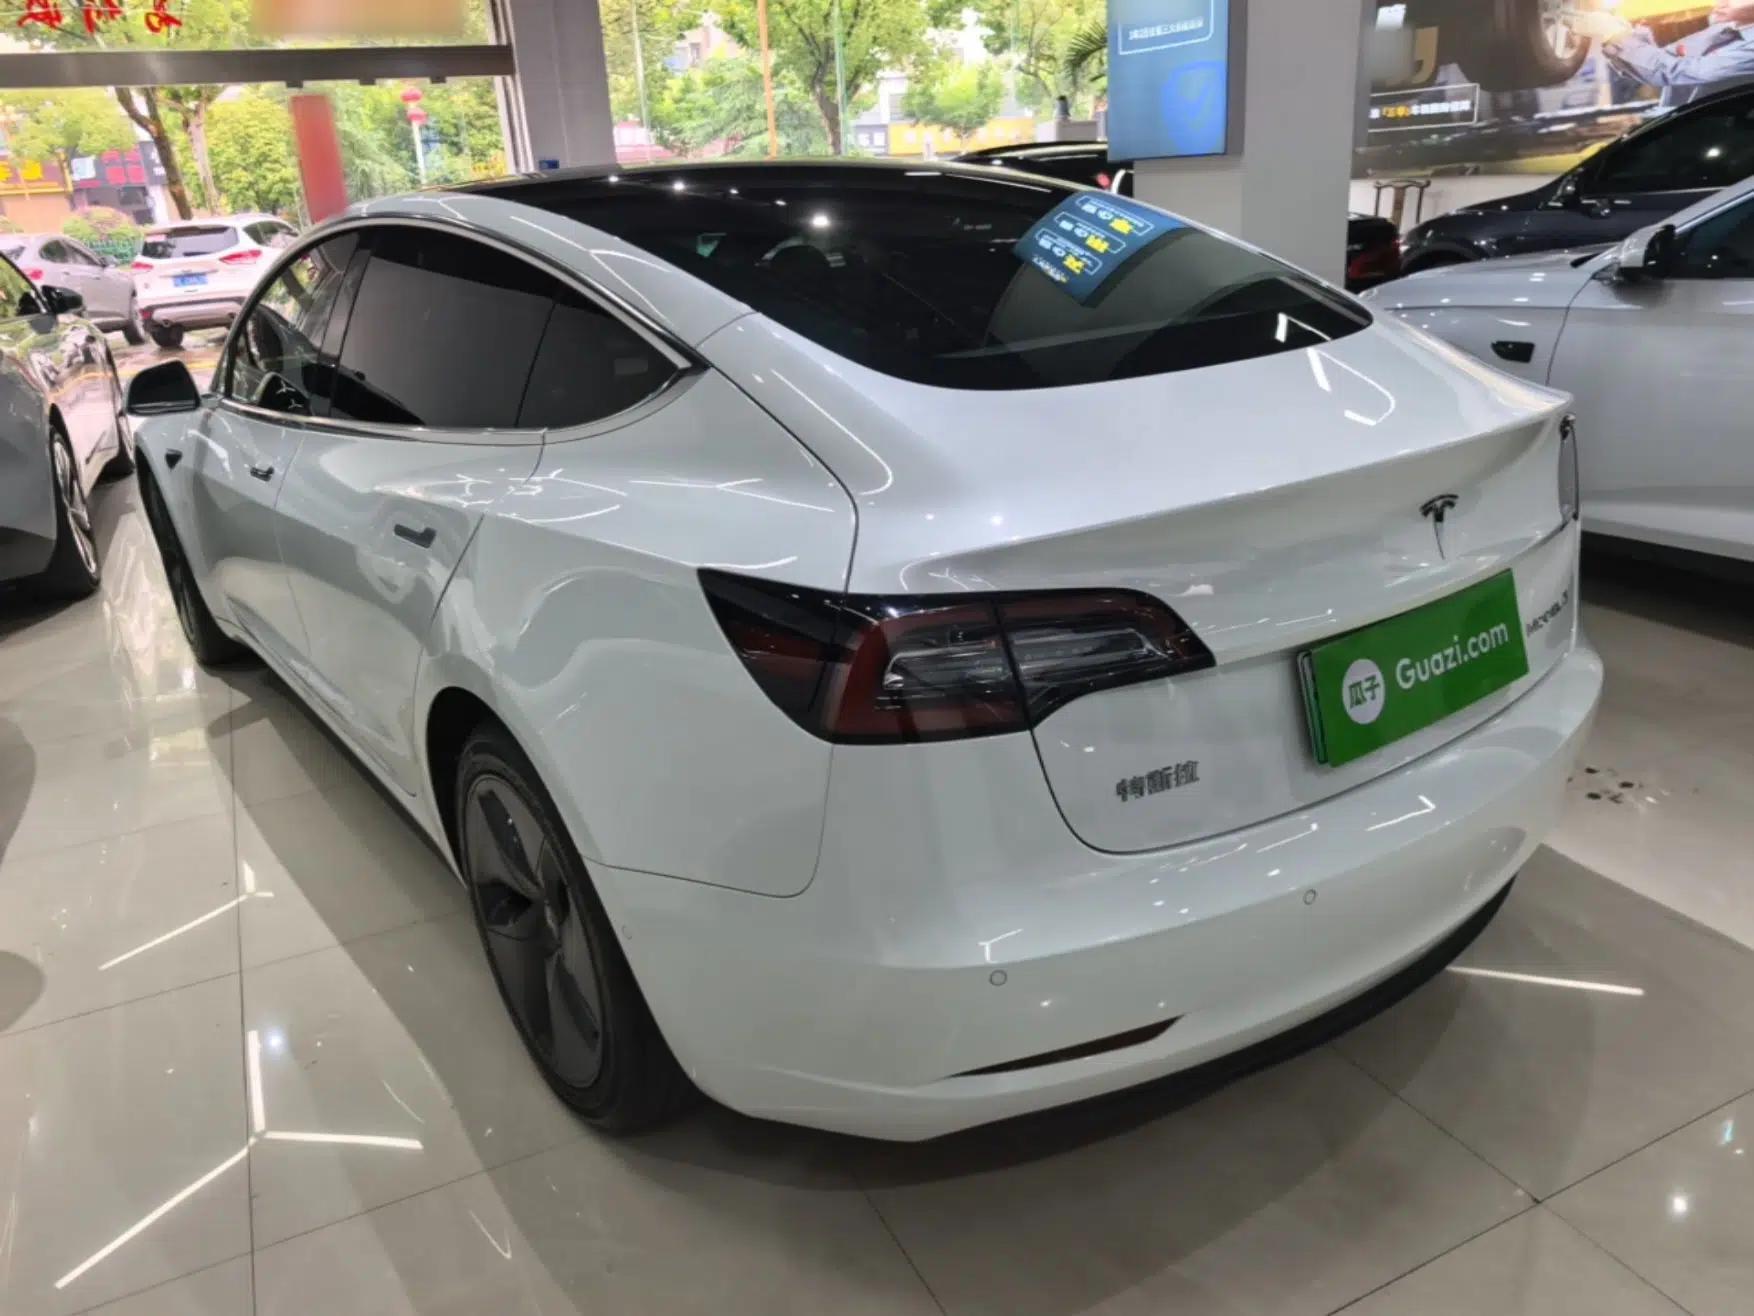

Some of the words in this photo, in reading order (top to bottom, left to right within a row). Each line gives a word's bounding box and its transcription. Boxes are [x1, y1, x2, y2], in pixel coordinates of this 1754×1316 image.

[1395, 622, 1509, 690] Guazi.com
[1348, 674, 1380, 709] 瓜子
[1116, 760, 1200, 802] 特斯拉
